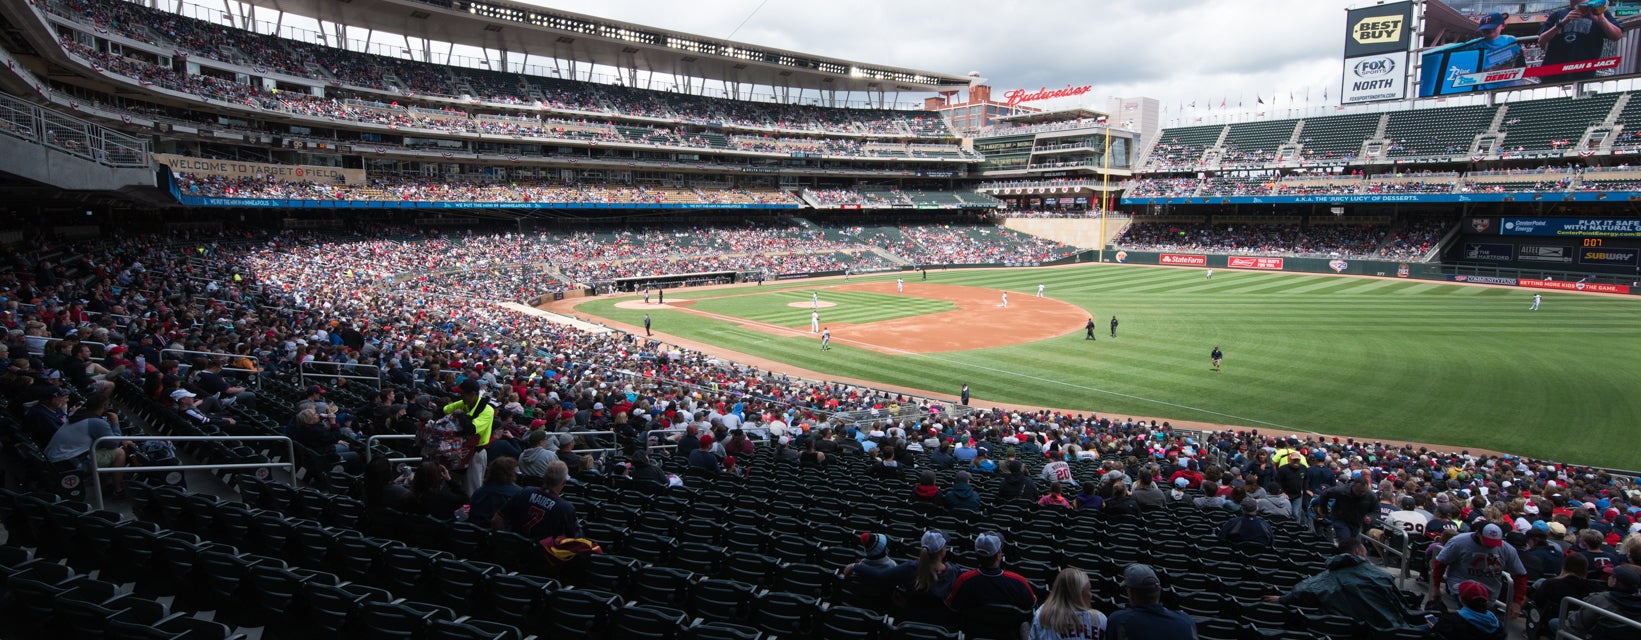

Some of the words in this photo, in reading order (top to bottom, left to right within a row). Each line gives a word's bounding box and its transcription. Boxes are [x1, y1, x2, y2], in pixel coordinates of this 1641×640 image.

[1360, 20, 1401, 31] BEST
[1360, 30, 1396, 40] BUY
[1362, 60, 1386, 71] FOX
[1562, 63, 1586, 71] NOAH
[1594, 59, 1617, 67] JACK
[1484, 72, 1519, 83] DEBUT
[1352, 78, 1394, 92] NORTH
[1004, 83, 1092, 106] Budweiser
[168, 158, 227, 172] WELCOME
[232, 163, 248, 173] TO
[249, 165, 294, 176] TARGET
[305, 169, 338, 179] FIELD
[1584, 252, 1633, 261] SUBWAY
[1467, 275, 1500, 284] COMMUNITY
[1056, 469, 1070, 480] 20
[529, 492, 556, 510] MAUER
[524, 506, 545, 533] 7
[1403, 522, 1424, 535] 29
